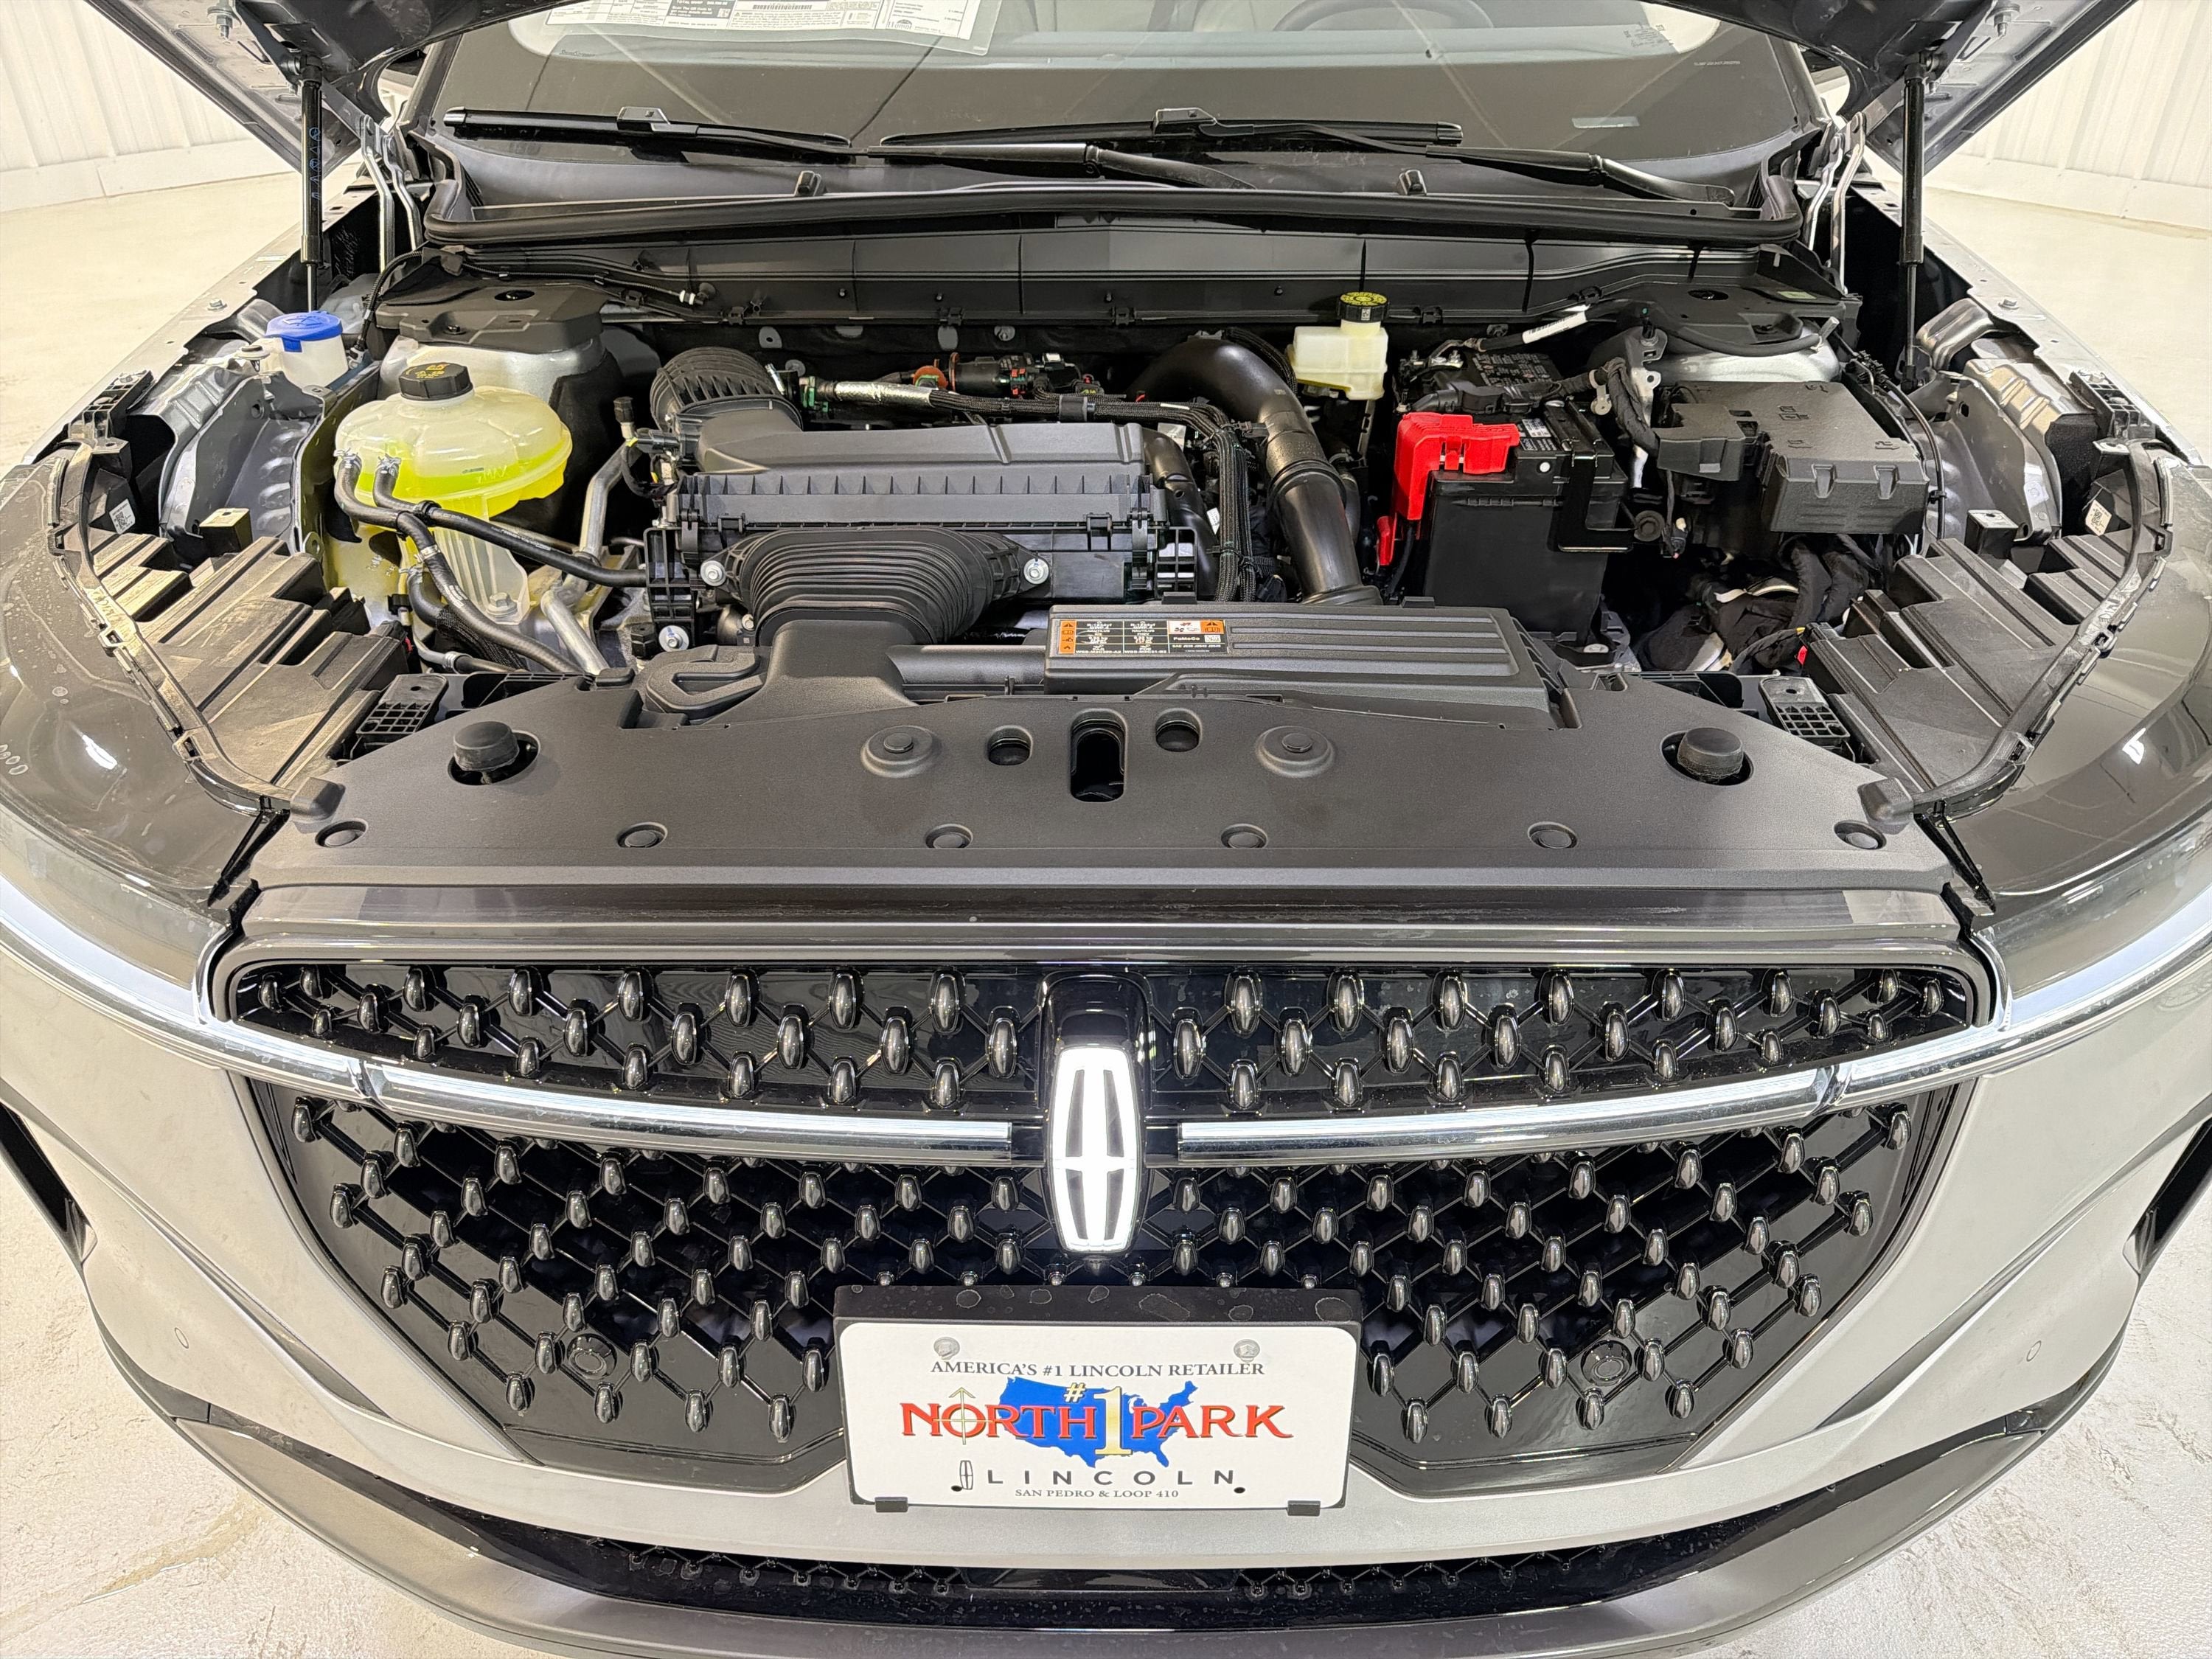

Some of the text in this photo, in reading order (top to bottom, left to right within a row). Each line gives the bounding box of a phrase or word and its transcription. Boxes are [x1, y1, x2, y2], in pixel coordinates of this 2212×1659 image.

[931, 1361, 1265, 1377] AMERICA'S #1 LINCOLN RETAILER
[900, 1402, 1294, 1439] NORTH PARK
[987, 1470, 1234, 1486] LINCOLN
[1015, 1489, 1179, 1498] SAN PEDRO & LOOP 410
